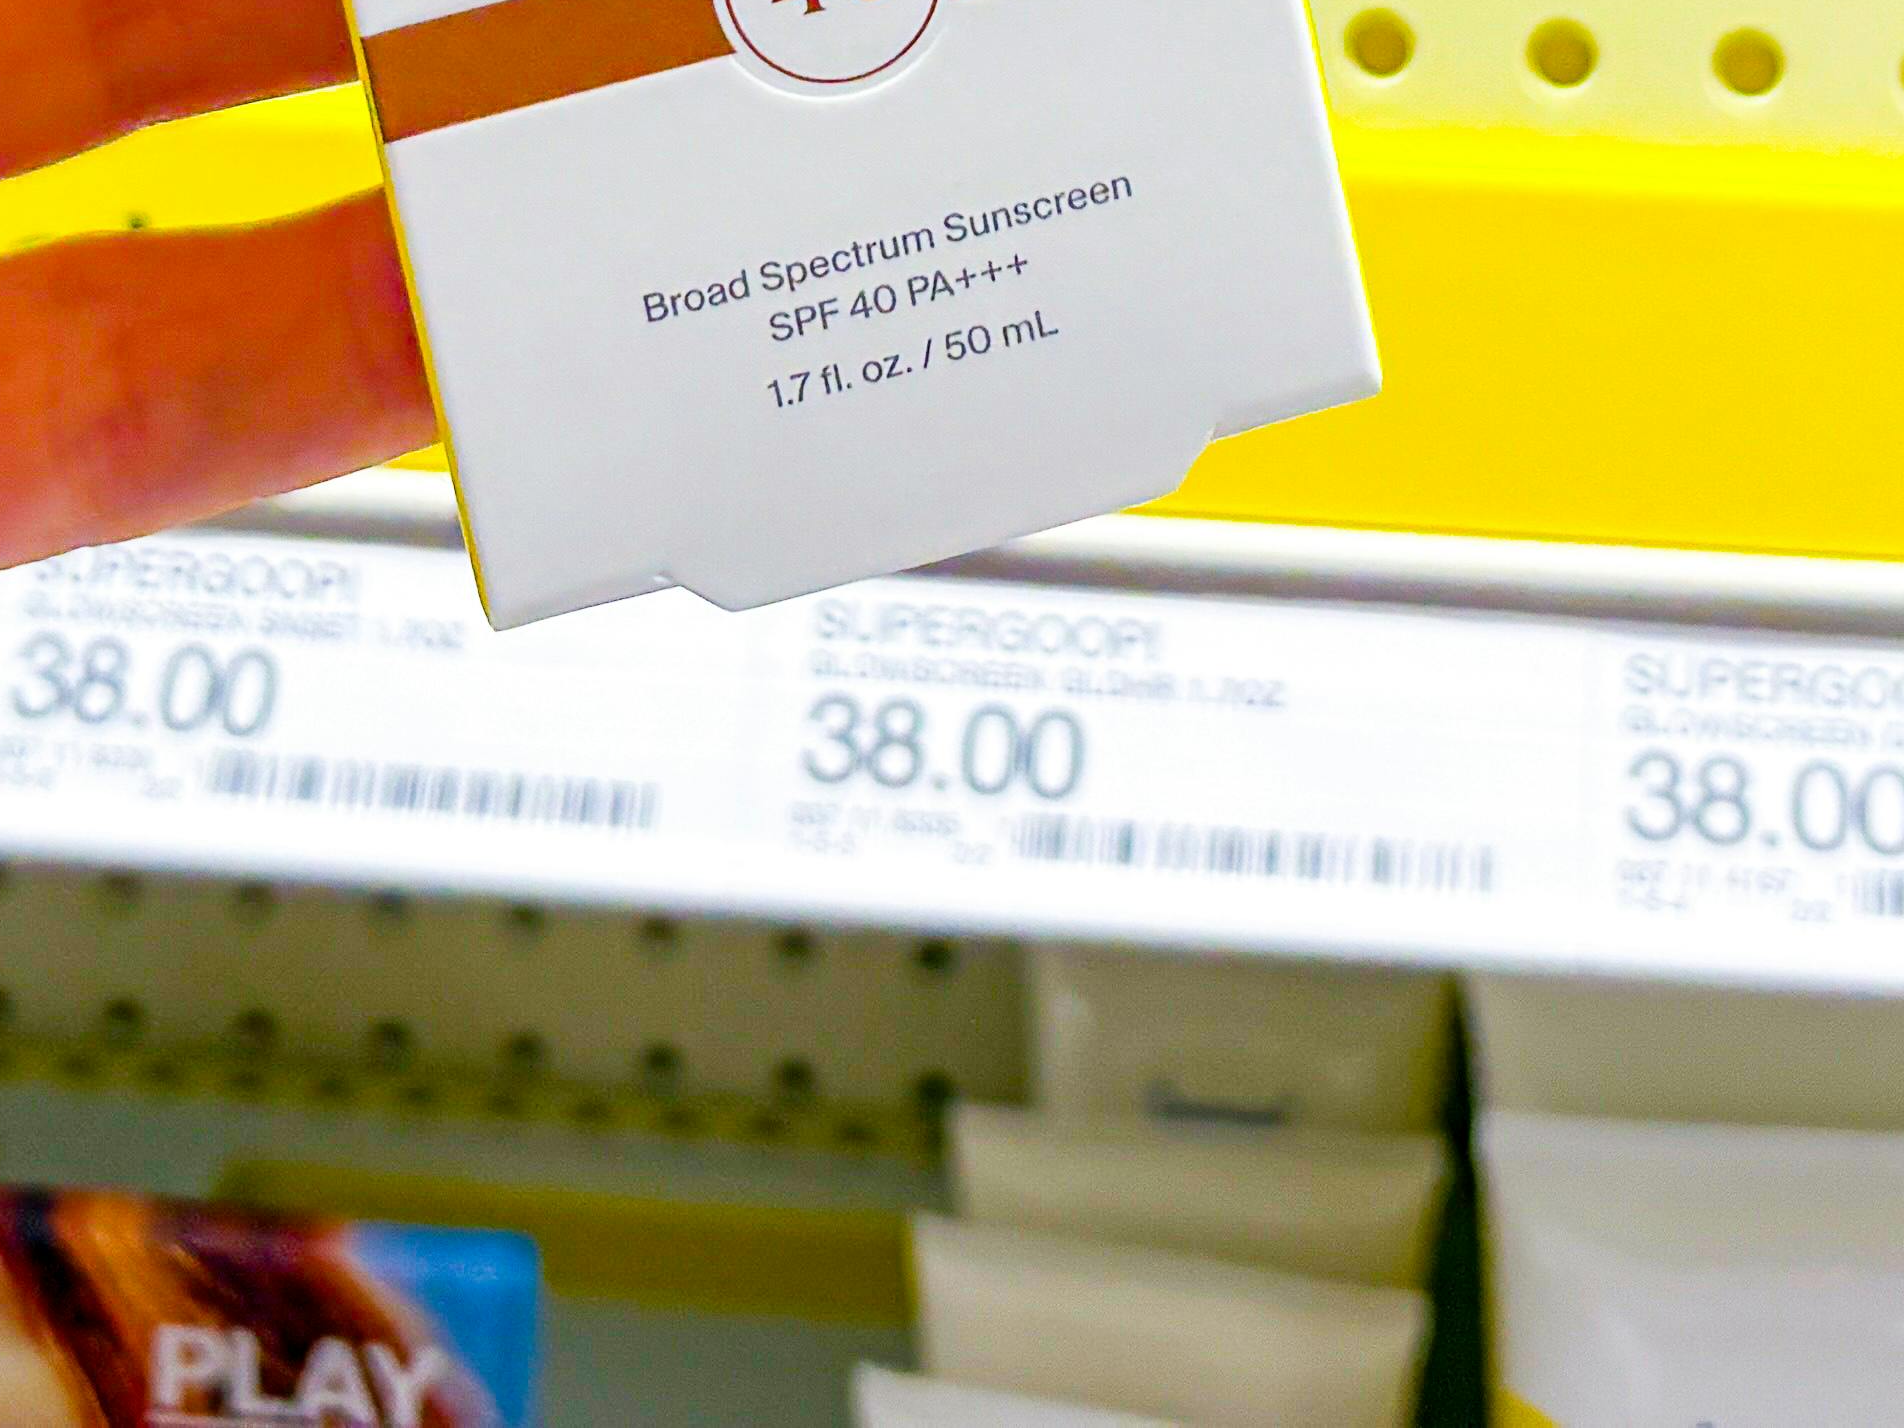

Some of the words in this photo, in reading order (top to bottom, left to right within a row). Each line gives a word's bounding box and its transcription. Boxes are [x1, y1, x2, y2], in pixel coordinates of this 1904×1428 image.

[642, 269, 751, 323] Broad
[759, 226, 936, 293] Spectrum
[943, 174, 1133, 243] Sunscreen
[768, 299, 842, 343] SPF
[848, 284, 898, 321] 40
[907, 252, 1029, 307] PA+++
[766, 371, 813, 409] 1.7
[819, 363, 853, 396] fl.
[861, 353, 914, 383] oz.
[921, 339, 934, 370] /
[944, 324, 992, 362] 50
[1001, 309, 1060, 348] mL
[11, 629, 280, 737] 38.00
[802, 691, 1088, 800] 38.00
[151, 1322, 451, 1428] PLAY
